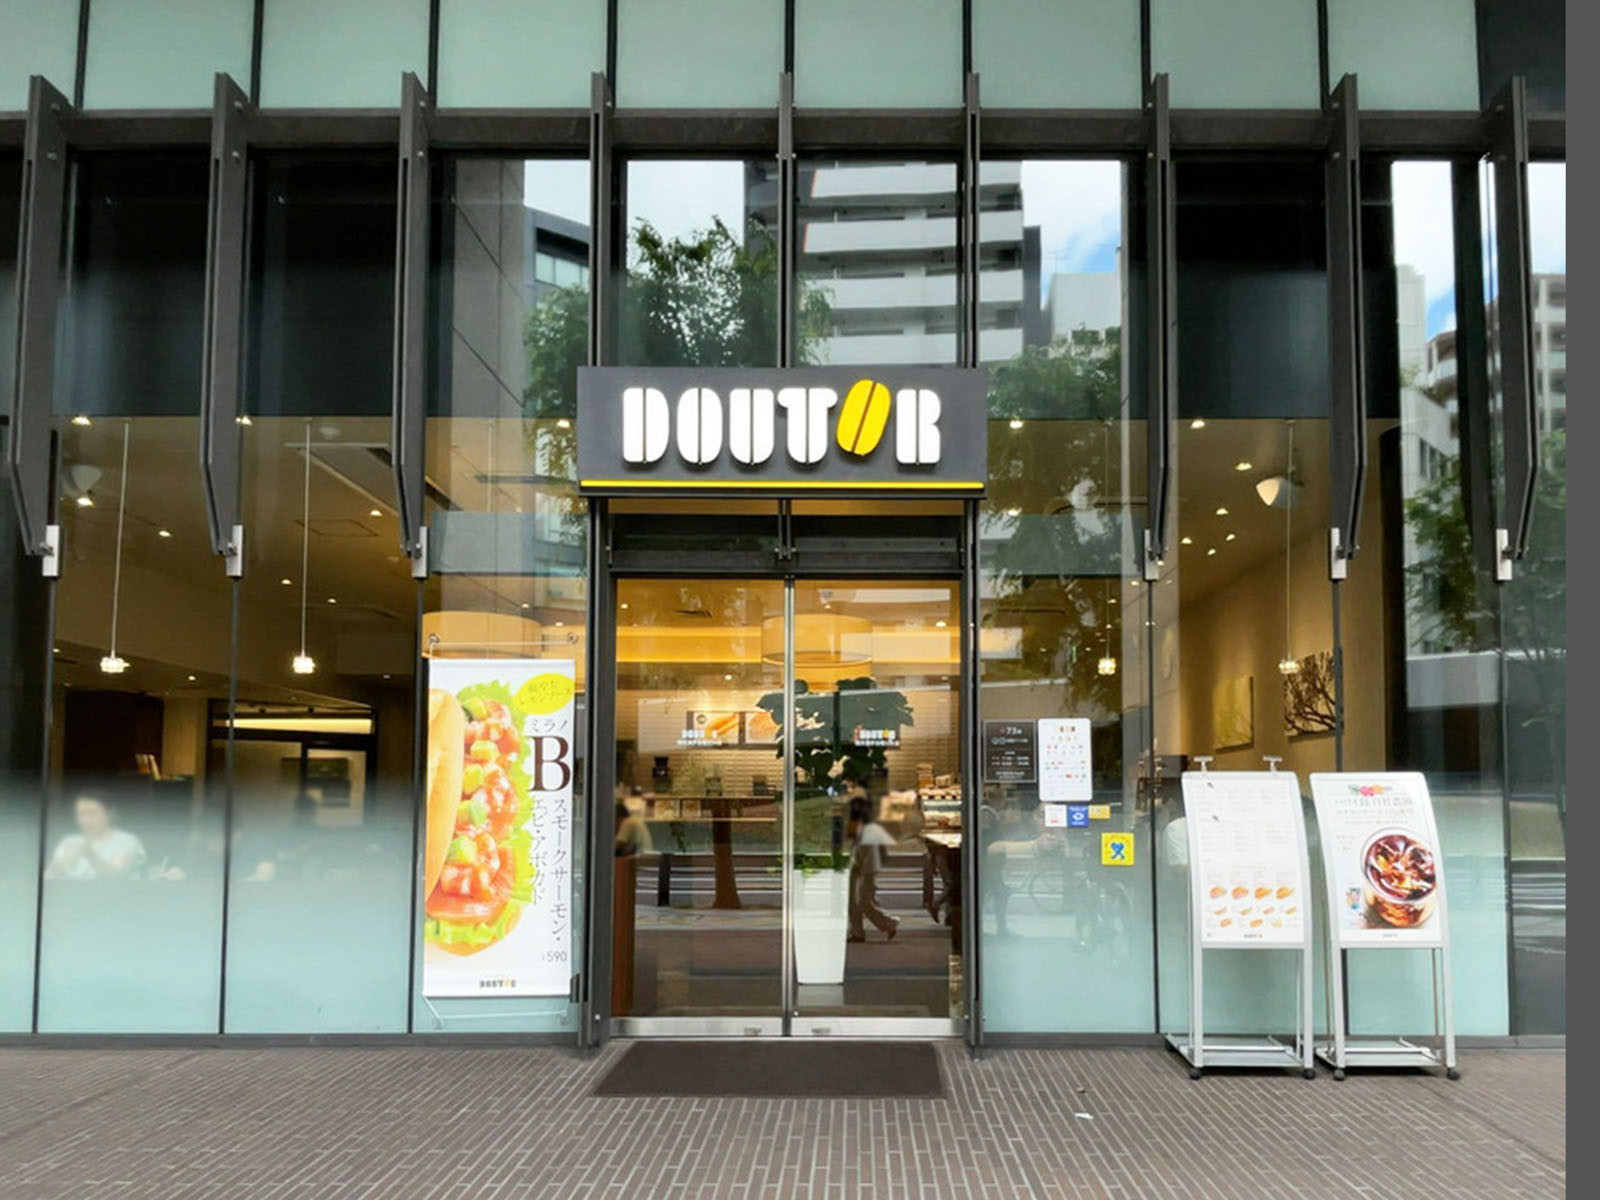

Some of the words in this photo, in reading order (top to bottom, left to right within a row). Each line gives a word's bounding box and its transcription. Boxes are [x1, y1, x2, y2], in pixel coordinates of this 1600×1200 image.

[622, 378, 942, 464] DOUTOR
[531, 718, 568, 733] ミラノ
[526, 735, 571, 792] B
[529, 799, 548, 906] エビ・アボカド
